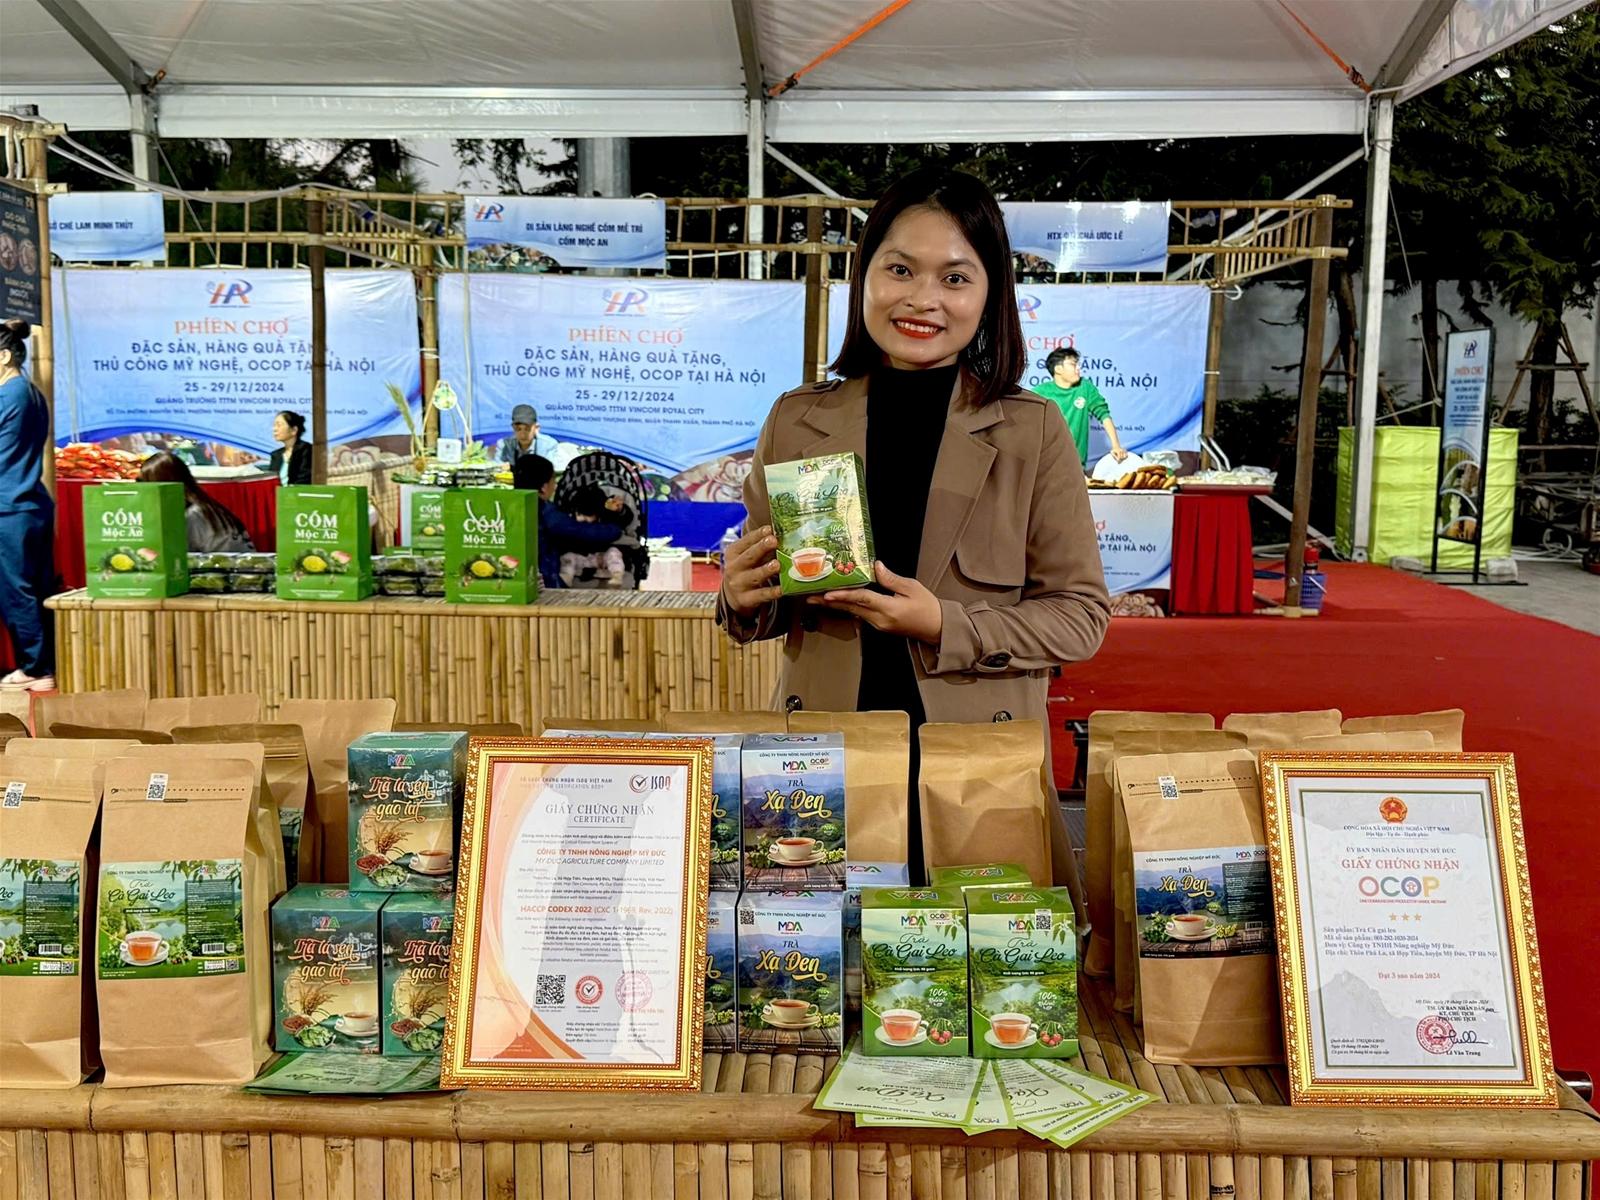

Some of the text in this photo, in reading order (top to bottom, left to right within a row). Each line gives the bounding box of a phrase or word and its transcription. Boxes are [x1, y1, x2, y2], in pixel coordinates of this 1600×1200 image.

[243, 316, 290, 339] CHỢ
[637, 325, 685, 348] CHỢ
[132, 336, 285, 357] ĐẶC SẢN, HÀNG QUÀ
[524, 345, 726, 368] ĐẶC SẢN, HÀNG QUÀ TẶNG,
[1081, 356, 1117, 373] ẶNG,
[93, 355, 120, 372] THỦ
[124, 356, 168, 372] CÔNG
[173, 355, 195, 373] MỸ
[200, 355, 243, 375] NGHỆ,
[249, 359, 292, 373] OCOP
[348, 356, 376, 376] NỘI
[484, 360, 766, 388] THỦ CÔNG MỸ NGHỆ, OCOP TẠI HÀ NỘI
[1105, 373, 1158, 391] HÀ NỘI
[185, 382, 200, 393] 25
[211, 381, 285, 394] 29/12/2024
[575, 389, 590, 400] 25
[601, 389, 675, 403] 29/12/2024
[102, 528, 126, 538] Mộc
[295, 529, 319, 541] Mộc
[463, 534, 487, 546] Mộc
[1107, 543, 1157, 554] TẠI HÀ NỘI
[783, 760, 808, 771] MDA
[650, 775, 672, 791] ISOQ
[787, 777, 804, 787] TRÀ
[545, 801, 655, 818] GIẤY CHỨNG NHẬN
[760, 788, 833, 819] Xạ Đen
[573, 815, 625, 824] CERTIFICATE
[568, 848, 588, 859] TNHH
[589, 848, 610, 860] NÔNG
[561, 858, 606, 867] AGRICULTURE
[606, 858, 639, 868] COMPANY
[640, 860, 665, 869] LIMITED
[1178, 865, 1193, 874] TRÀ
[1341, 856, 1460, 873] GIẤY CHỨNG NHẬN
[1158, 874, 1217, 898] Xạ Đen
[1358, 876, 1440, 897] OCOP
[127, 888, 149, 907] Gai
[150, 887, 176, 903] Leo
[547, 905, 574, 914] CODEX
[574, 905, 592, 914] 2022
[778, 920, 803, 932] MDA
[901, 915, 928, 926] MDA
[1009, 919, 1035, 930] MDA
[782, 939, 800, 950] TRÀ
[896, 943, 925, 965] Gai
[925, 943, 958, 961] Leo
[1004, 947, 1034, 969] Gai
[1034, 948, 1067, 964] Leo
[754, 949, 829, 982] Xạ Đen
